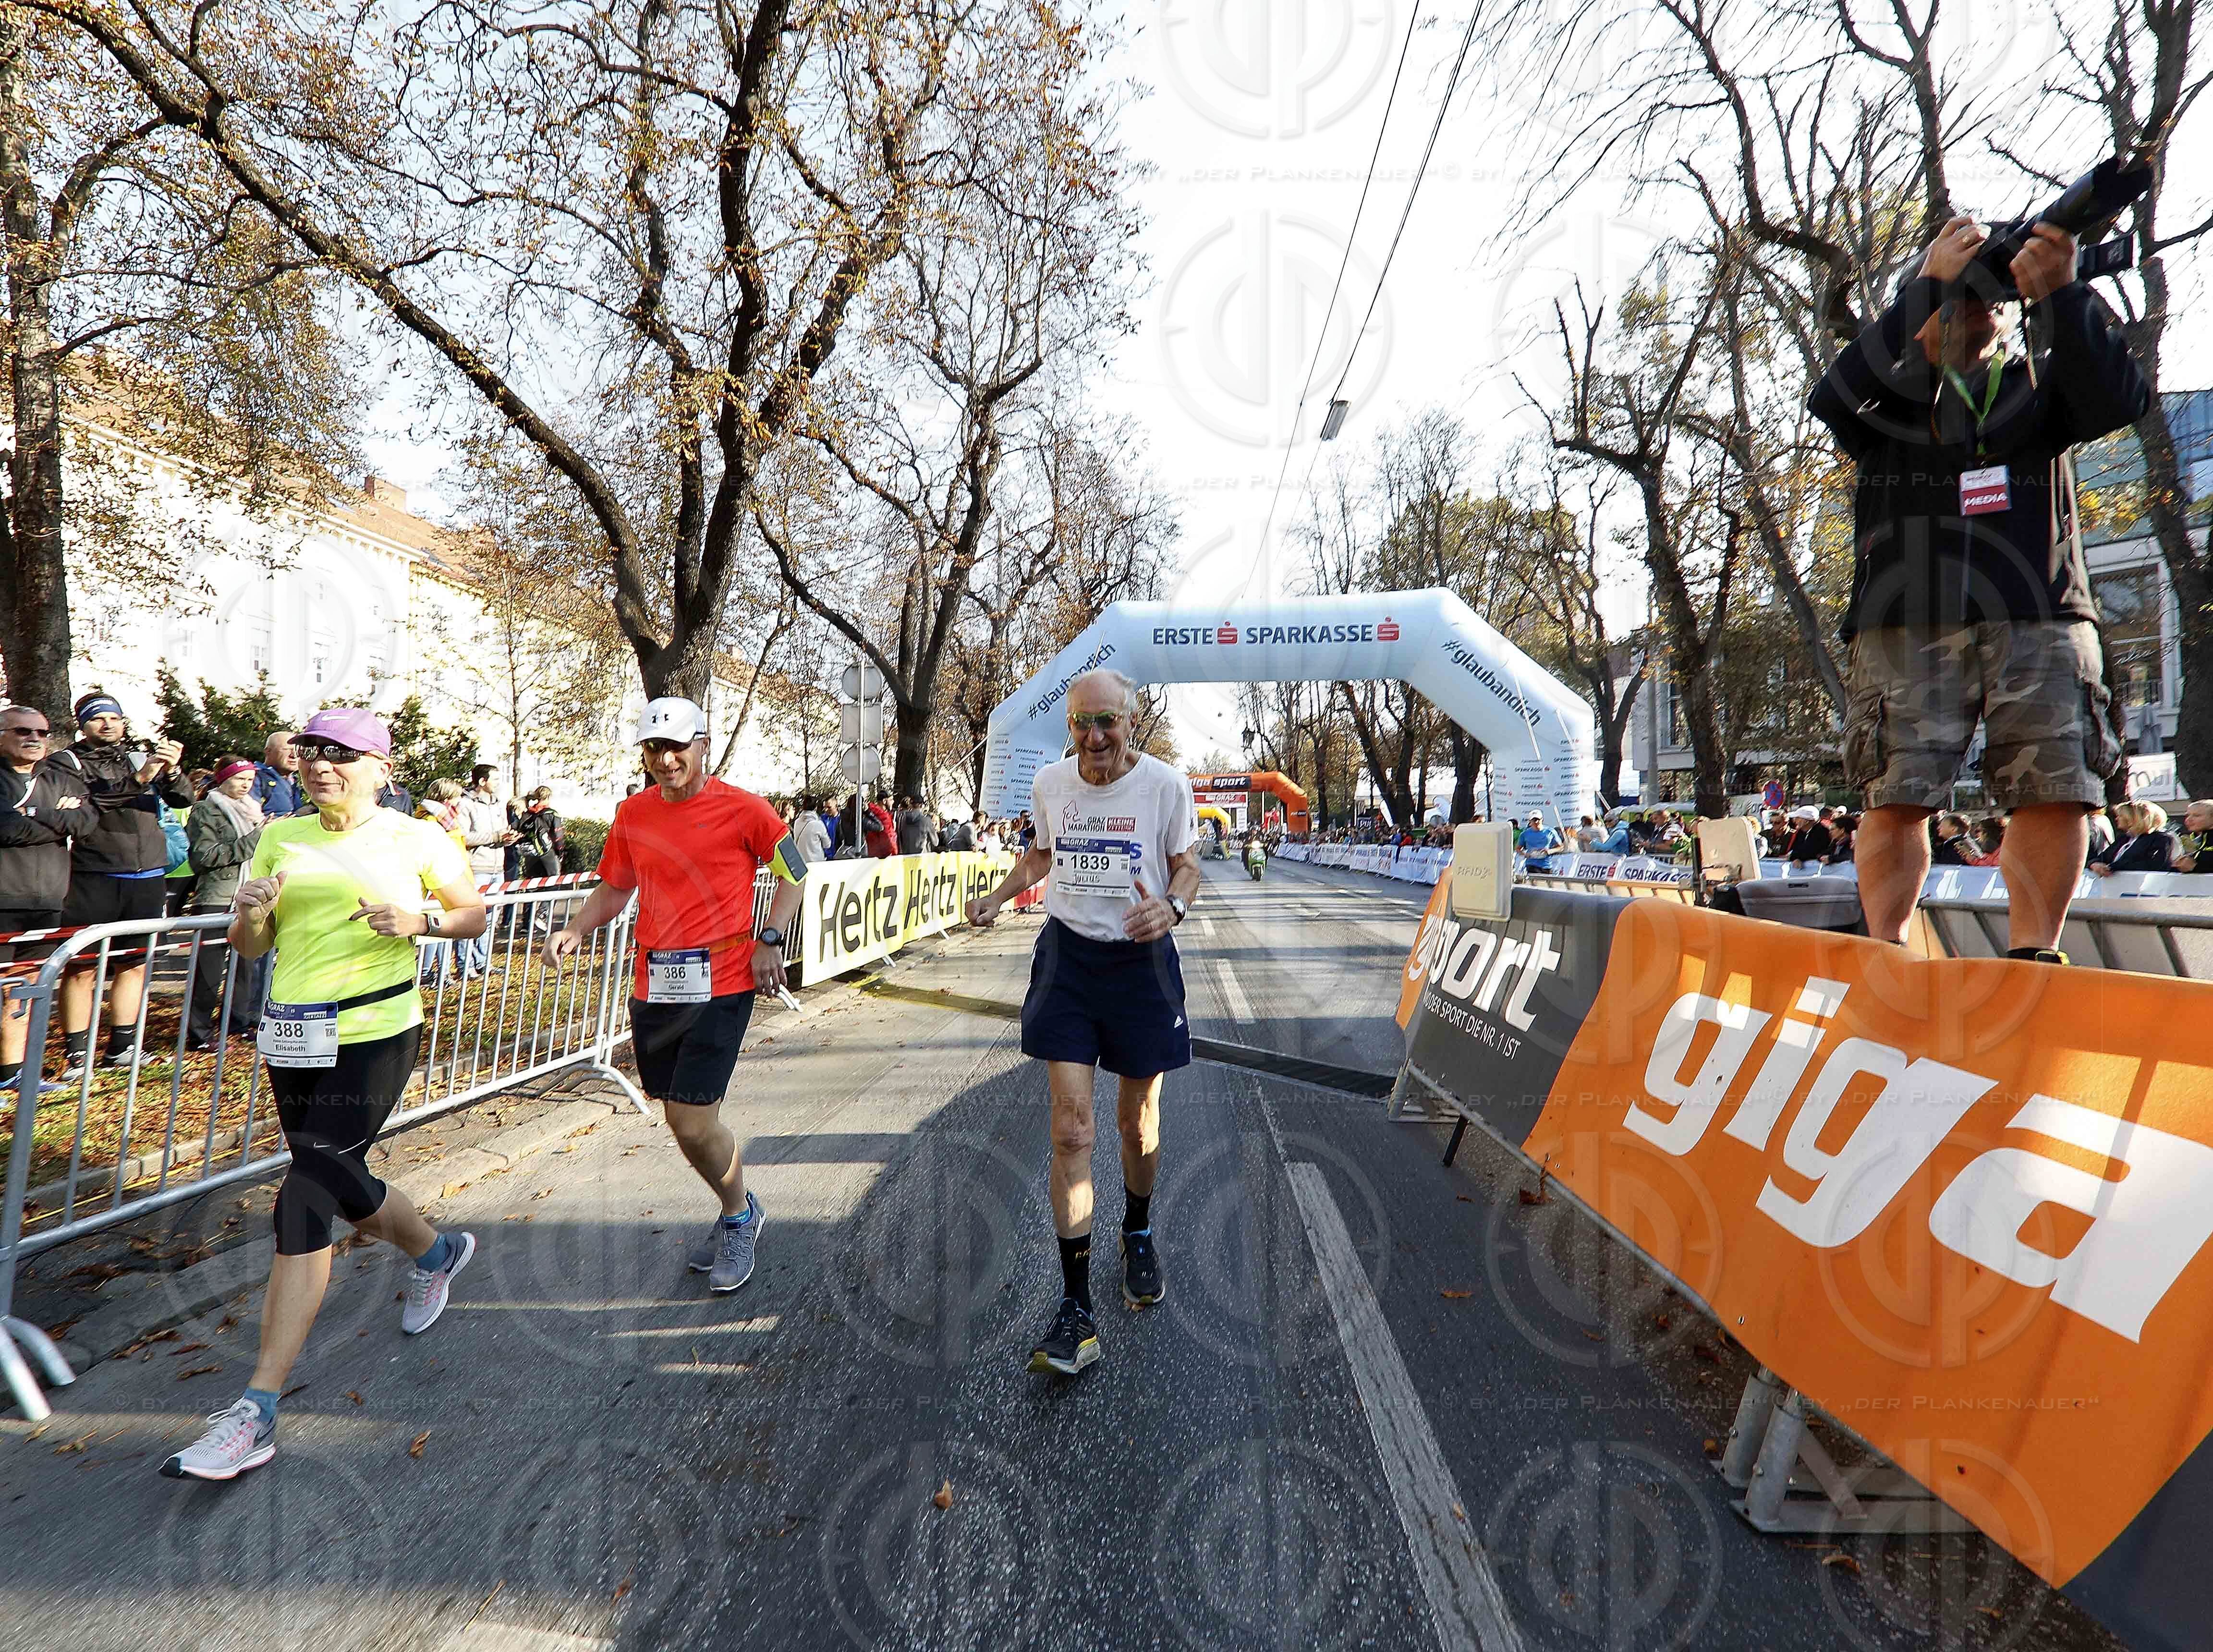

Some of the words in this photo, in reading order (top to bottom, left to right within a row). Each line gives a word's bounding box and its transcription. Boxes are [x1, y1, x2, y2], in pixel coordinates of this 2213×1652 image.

[1964, 492, 2007, 508] MEDIA
[1153, 627, 1213, 645] ERSTE
[1246, 624, 1373, 645] SPARKASSE
[1028, 644, 1116, 720] #glaubndich
[1213, 776, 1246, 788] sport
[1068, 823, 1106, 832] MARATHON
[1108, 817, 1134, 826] KLEINE
[1070, 854, 1110, 870] 1839
[1578, 864, 1607, 878] ERSTE
[904, 866, 956, 930] Hertz
[819, 876, 897, 962] Hertz
[664, 966, 686, 979] 386
[274, 1021, 304, 1038] 388
[1439, 1001, 1468, 1029] SPORT
[1465, 1014, 1483, 1038] DIE
[1479, 1022, 1496, 1048] NR.
[1496, 1032, 1505, 1051] 1
[1502, 1035, 1522, 1060] IST
[275, 1044, 306, 1052] Elisabeth
[1622, 976, 2213, 1344] giga
